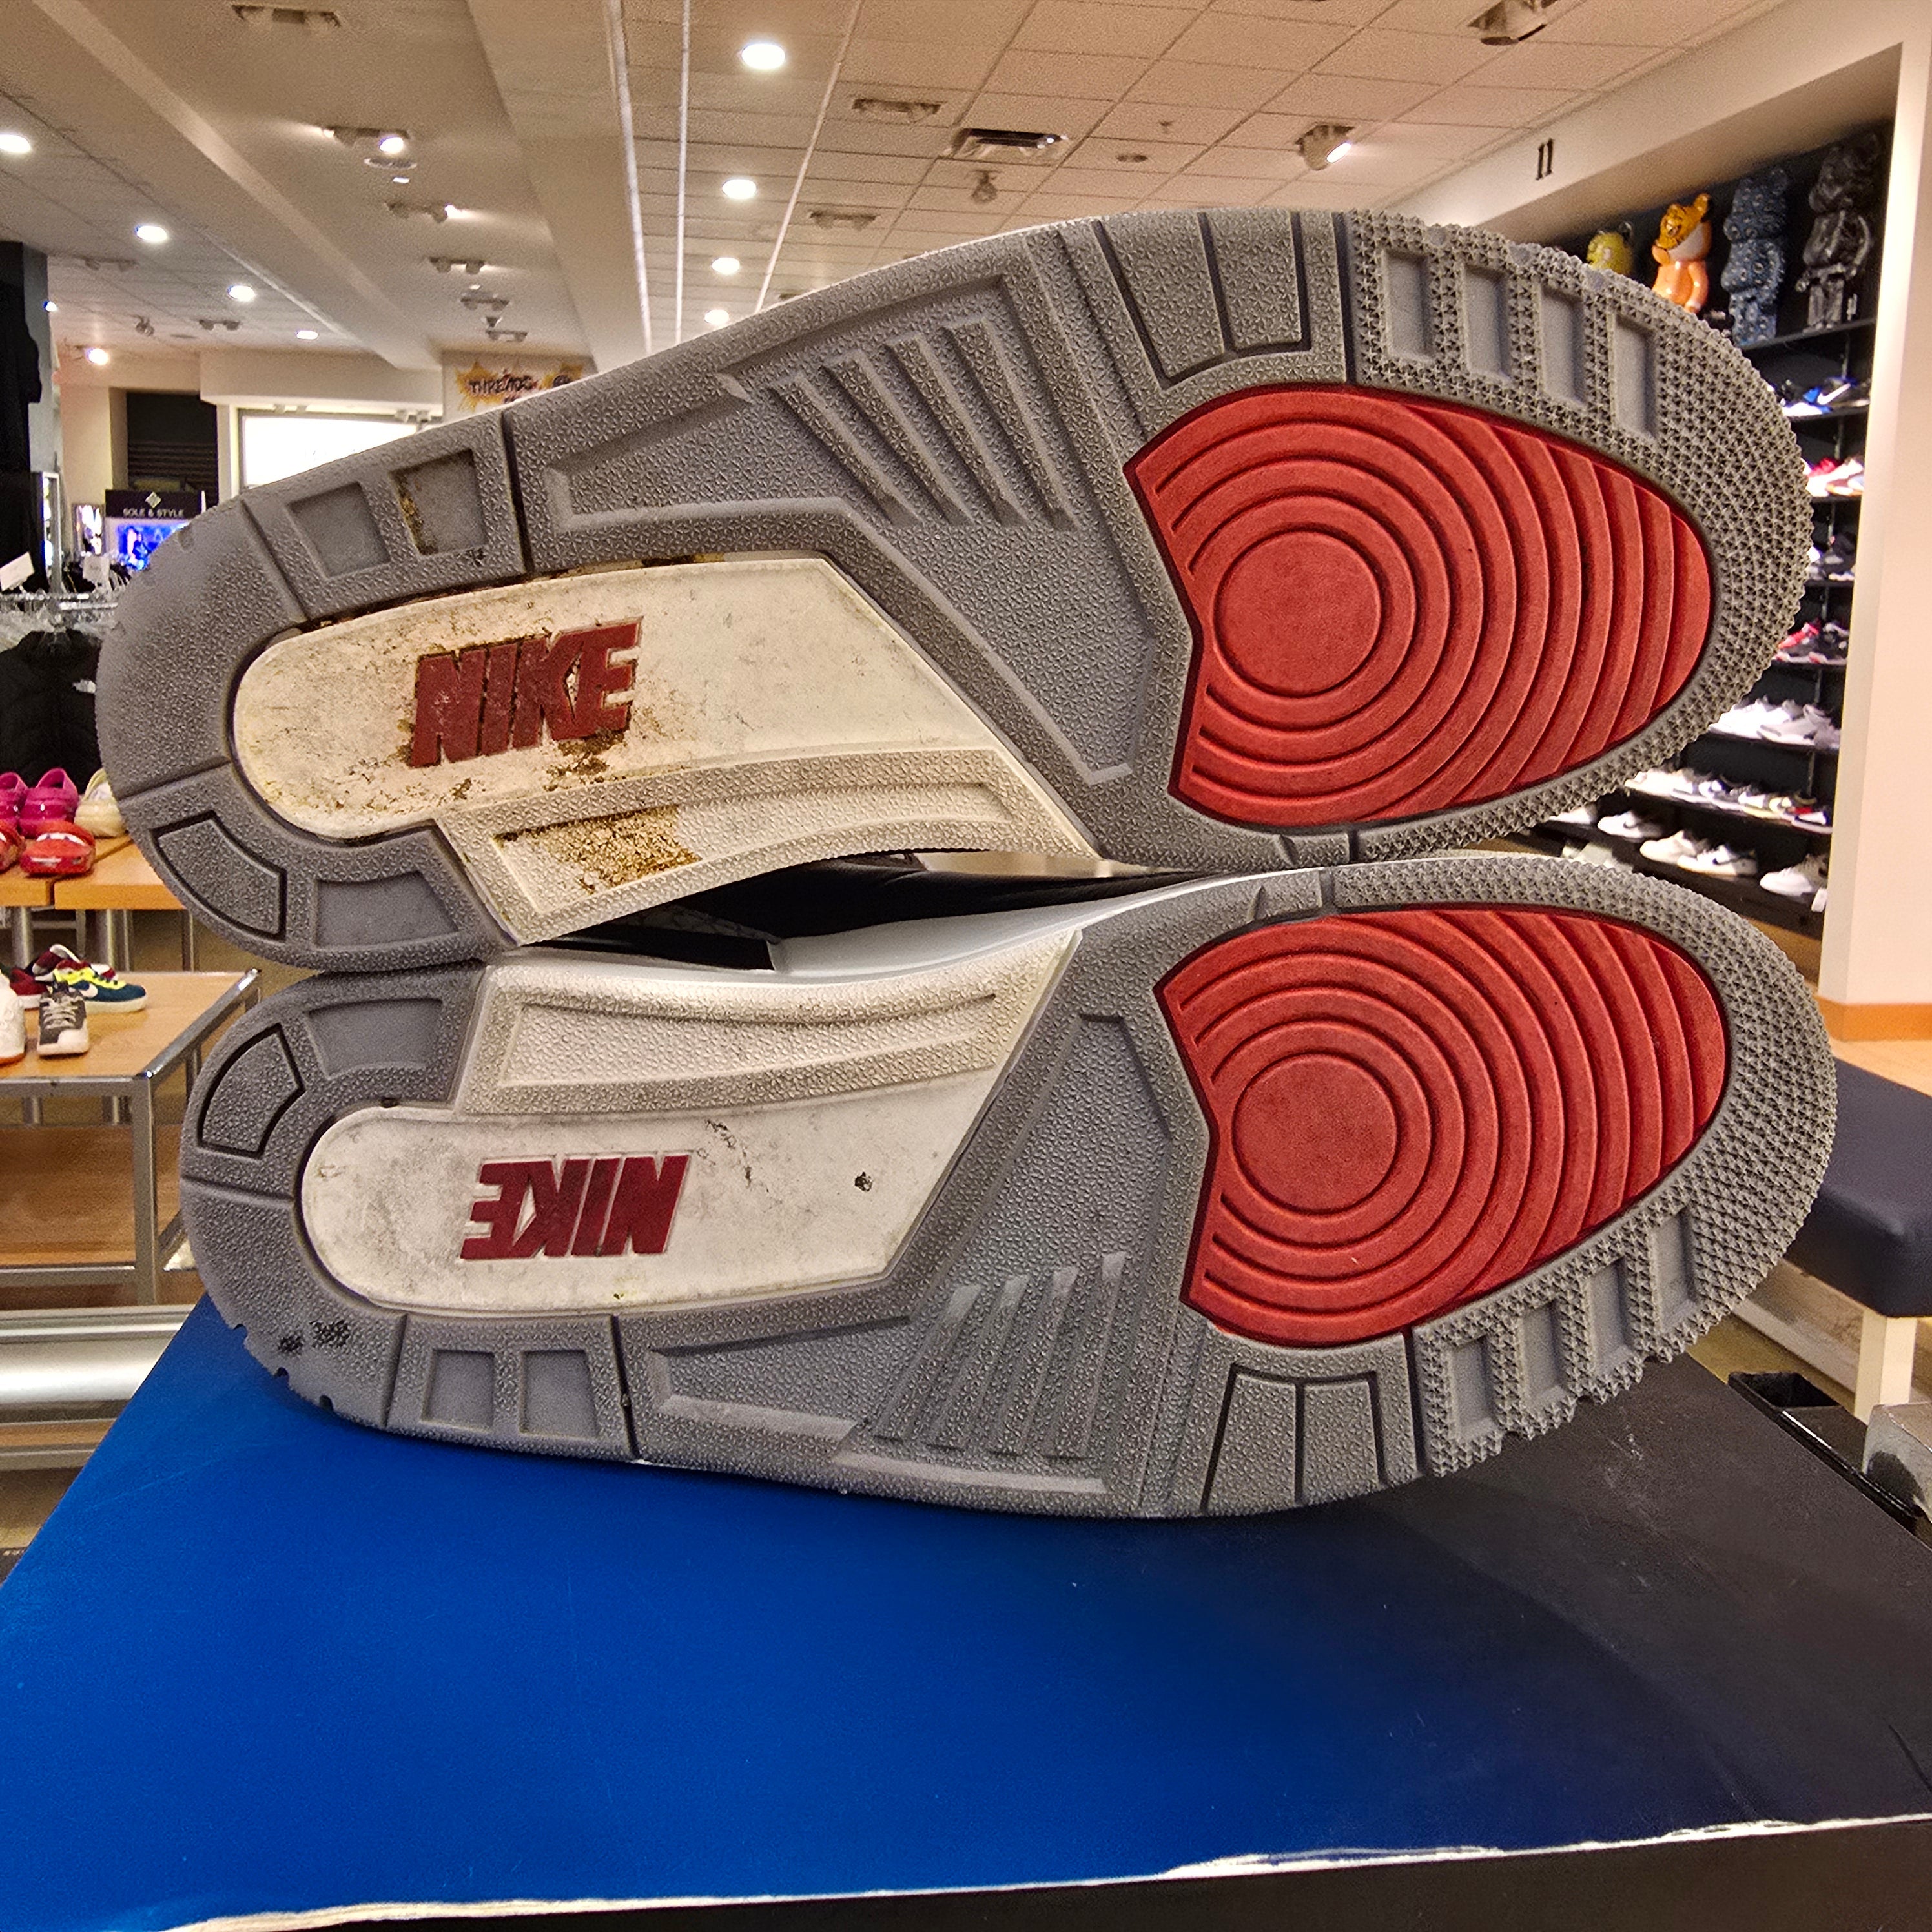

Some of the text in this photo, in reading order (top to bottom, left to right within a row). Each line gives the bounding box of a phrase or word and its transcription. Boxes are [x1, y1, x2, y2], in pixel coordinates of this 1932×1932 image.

[123, 508, 145, 517] SOLE
[157, 509, 185, 517] STYLE
[409, 617, 644, 768] NIKE
[459, 1154, 690, 1260] NIKE
